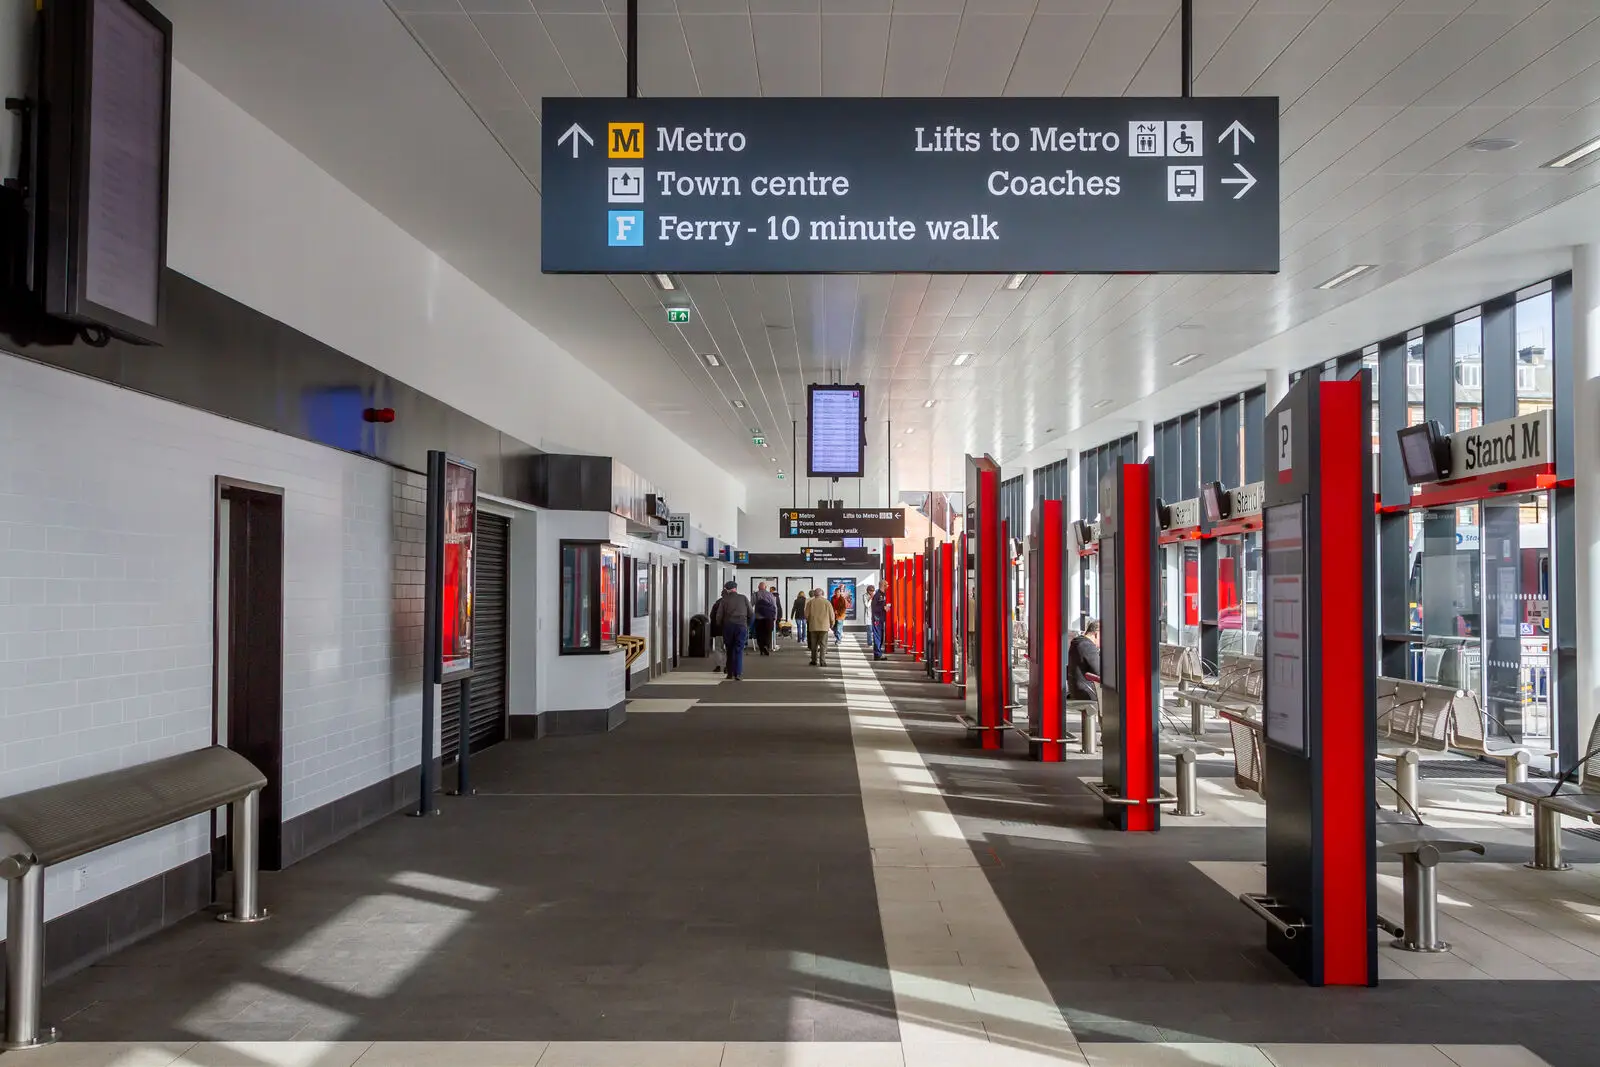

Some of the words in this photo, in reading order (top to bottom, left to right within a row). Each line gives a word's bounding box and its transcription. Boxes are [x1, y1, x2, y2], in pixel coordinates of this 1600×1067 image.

[612, 128, 640, 152] M
[656, 127, 746, 152] Metro
[914, 125, 981, 152] Lifts
[989, 127, 1020, 152] to
[1029, 127, 1120, 152] Metro
[656, 170, 742, 196] Town
[750, 171, 850, 196] centre
[987, 169, 1121, 196] Coaches
[616, 216, 636, 240] F
[658, 215, 741, 246] Ferry
[767, 215, 801, 241] 10
[809, 214, 917, 241] minute
[924, 213, 1000, 241] walk
[1281, 424, 1289, 459] P
[1466, 424, 1517, 470] Stand
[1522, 420, 1541, 460] M
